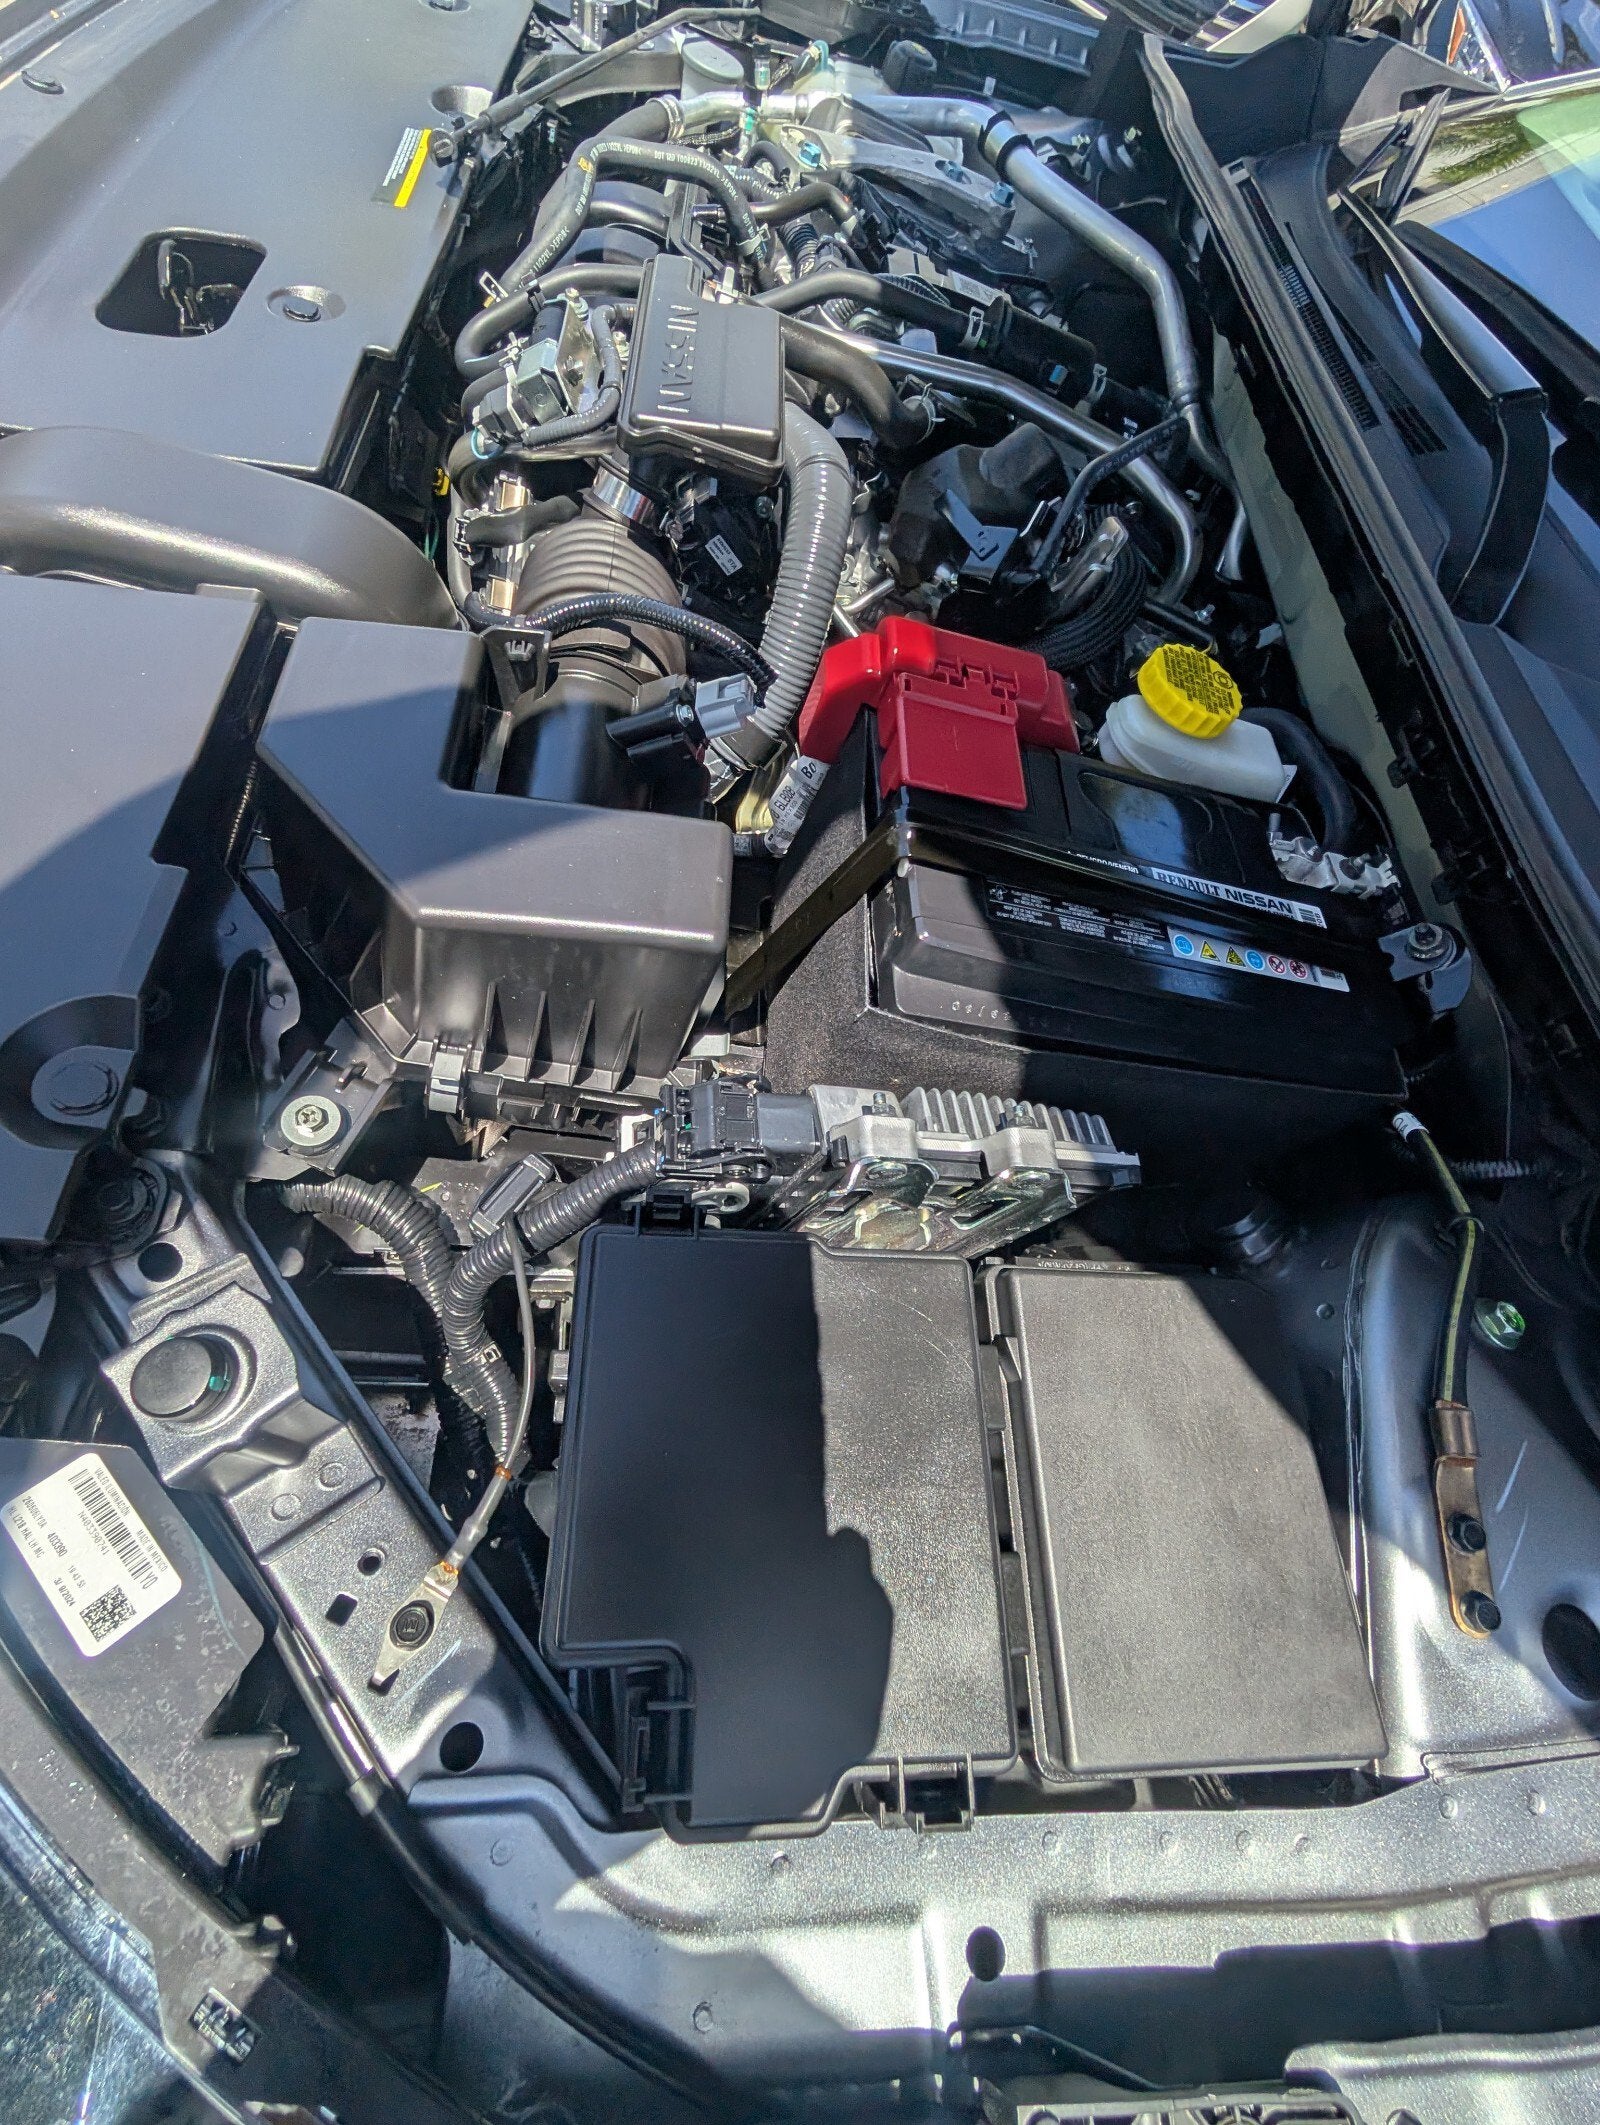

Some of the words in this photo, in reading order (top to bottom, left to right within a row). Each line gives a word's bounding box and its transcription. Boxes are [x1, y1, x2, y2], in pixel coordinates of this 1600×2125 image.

[657, 304, 700, 413] NISSAN
[1156, 871, 1222, 897] RENAULT
[1225, 887, 1293, 914] NISSAN
[94, 1468, 110, 1485] VALEO
[47, 1532, 68, 1558] 403390
[77, 1511, 110, 1556] N403390741
[136, 1529, 151, 1547] MADE
[150, 1550, 168, 1573] MEXICO
